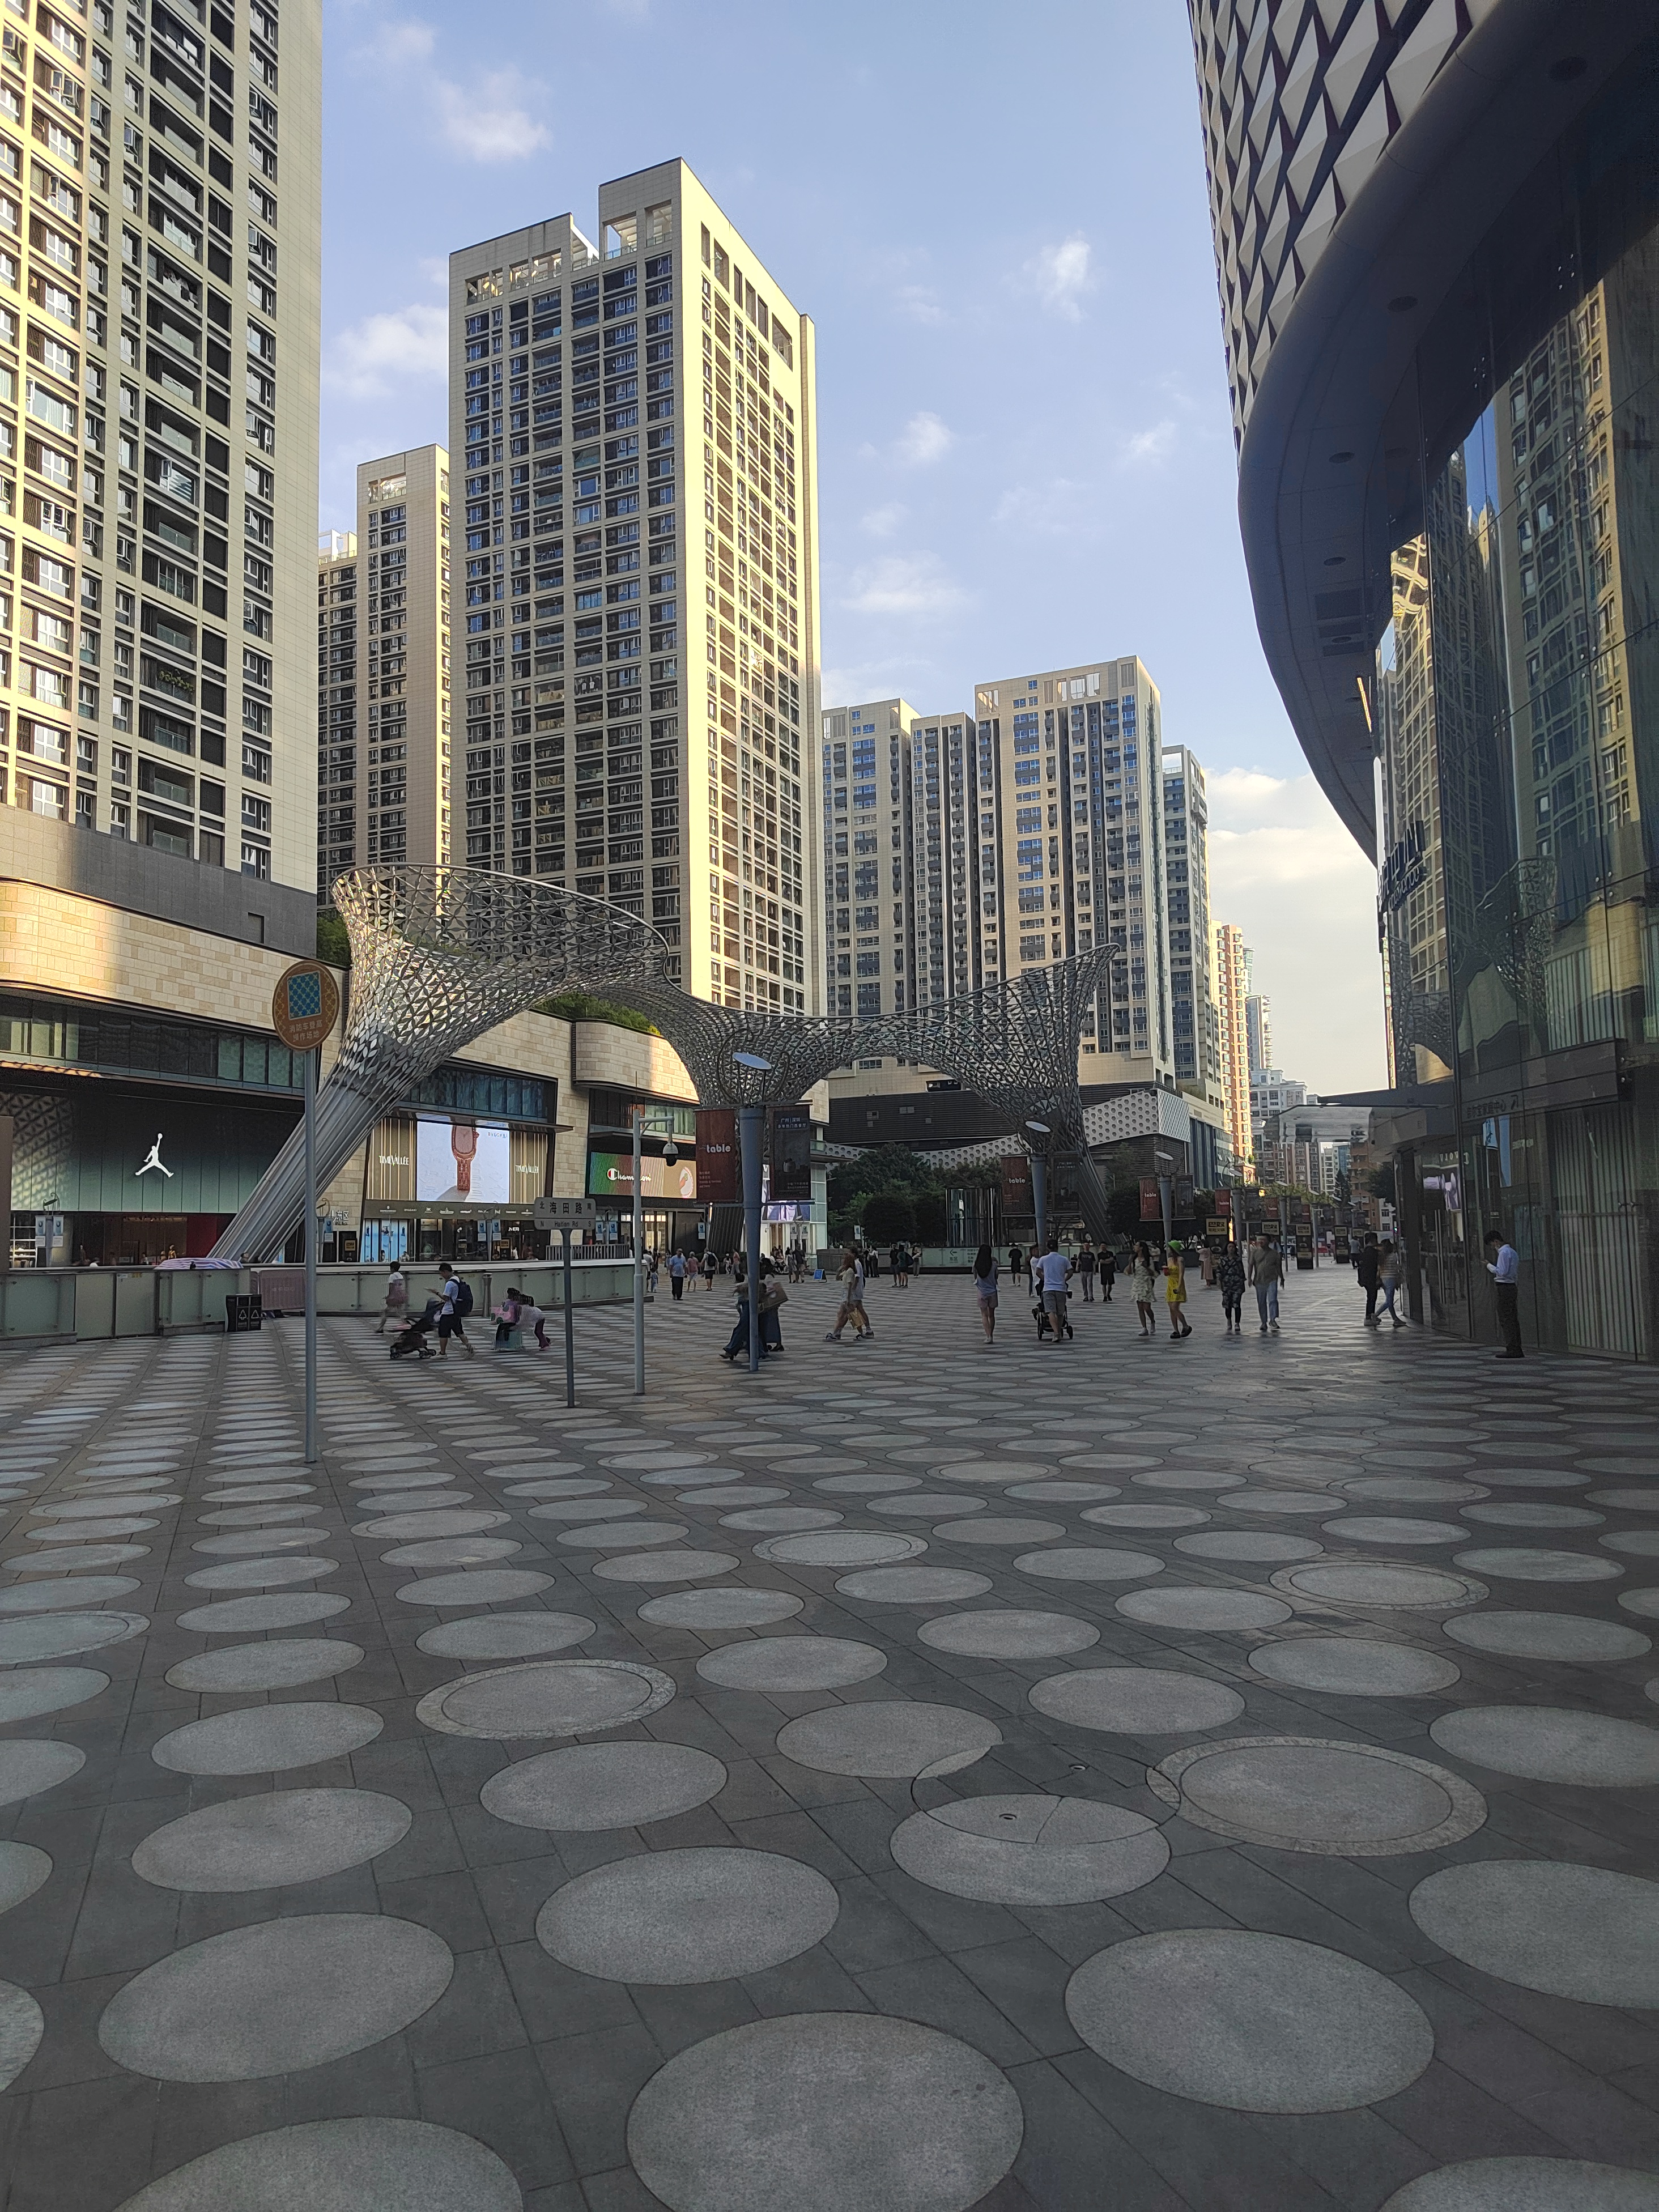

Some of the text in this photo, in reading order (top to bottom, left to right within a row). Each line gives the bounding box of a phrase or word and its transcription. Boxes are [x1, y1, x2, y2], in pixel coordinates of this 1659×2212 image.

[289, 1020, 322, 1033] 消防车登高
[293, 1031, 320, 1041] 操作场地
[707, 1143, 731, 1152] table
[607, 1168, 652, 1182] Chamon
[550, 1202, 582, 1214] 海田路
